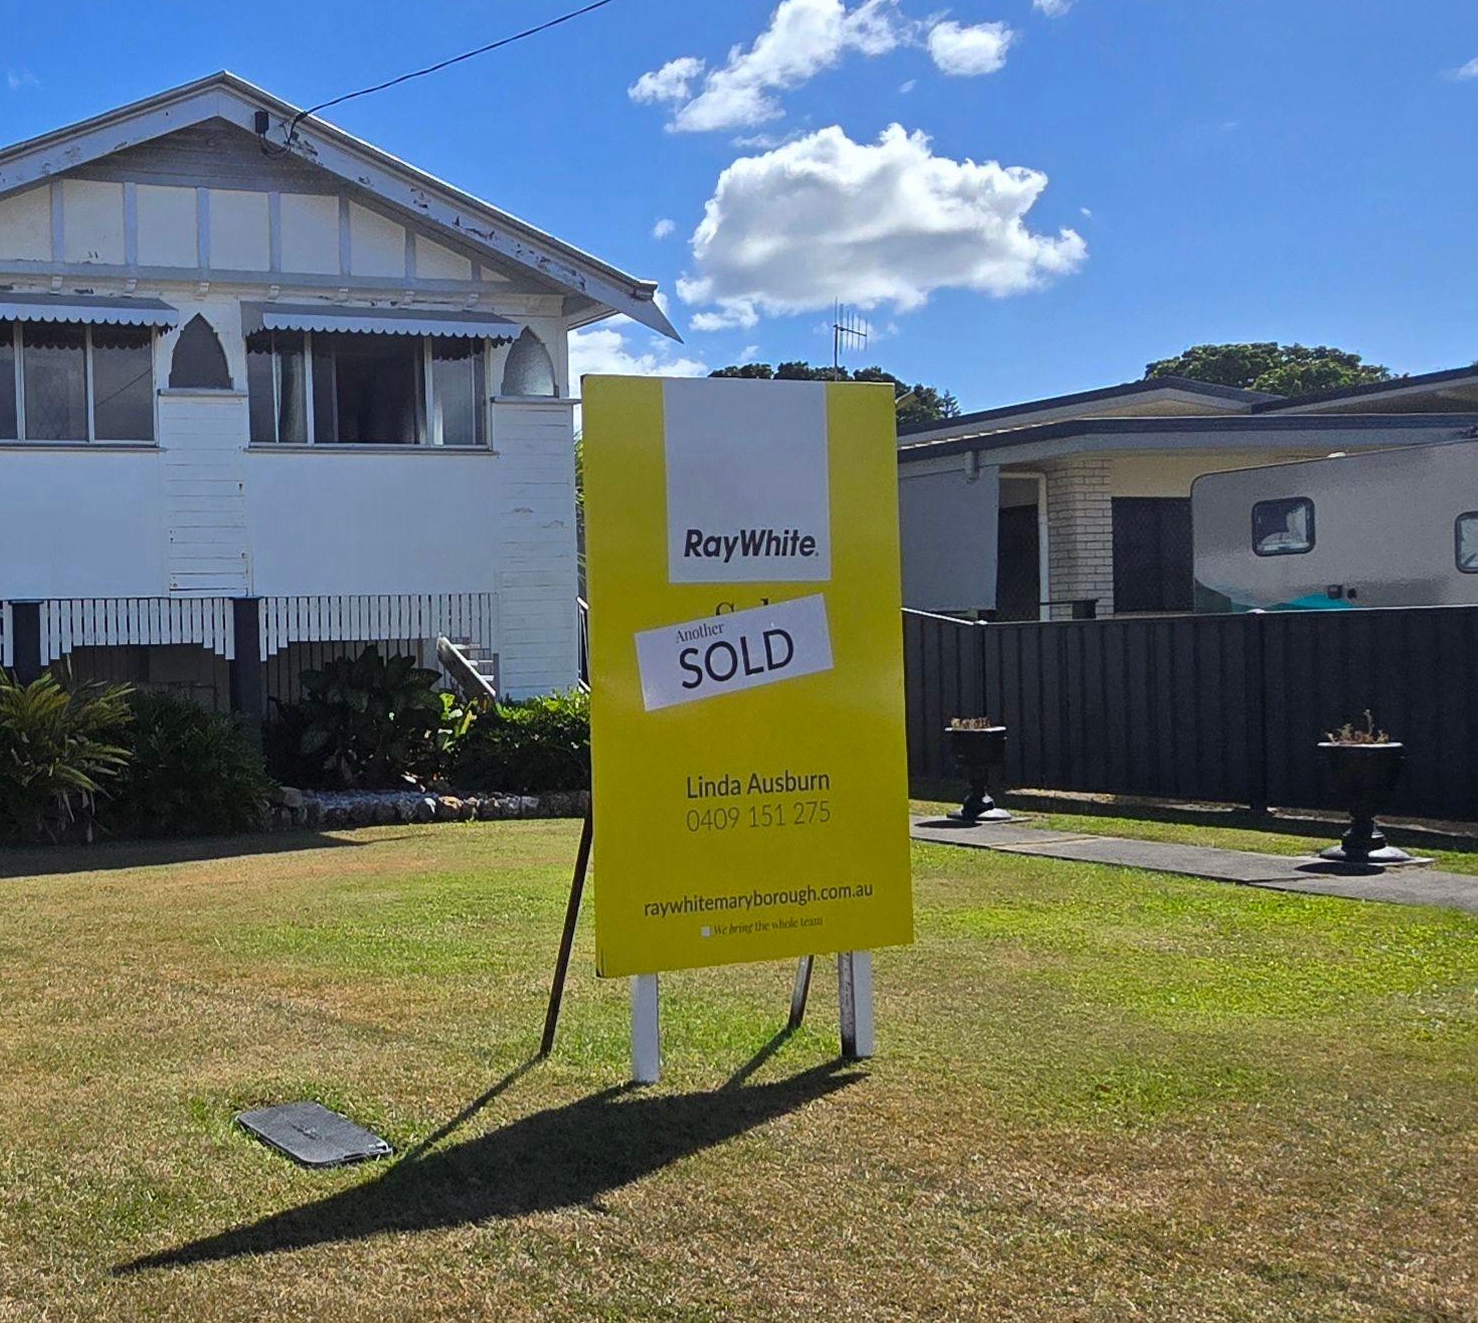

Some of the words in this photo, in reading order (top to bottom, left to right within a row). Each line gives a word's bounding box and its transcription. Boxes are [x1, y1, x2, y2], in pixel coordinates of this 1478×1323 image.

[676, 622, 725, 644] Another
[679, 628, 794, 689] SOLD
[687, 774, 741, 799] Linda
[747, 770, 830, 794] Ausburn
[686, 806, 740, 832] 0409
[748, 804, 786, 828] 151
[793, 800, 831, 825] 275
[643, 884, 873, 918] raywhitemaryborough.com.au
[714, 924, 728, 936] We
[728, 922, 754, 935] bring
[754, 920, 770, 932] the
[770, 917, 799, 930] whole
[800, 916, 823, 927] team
